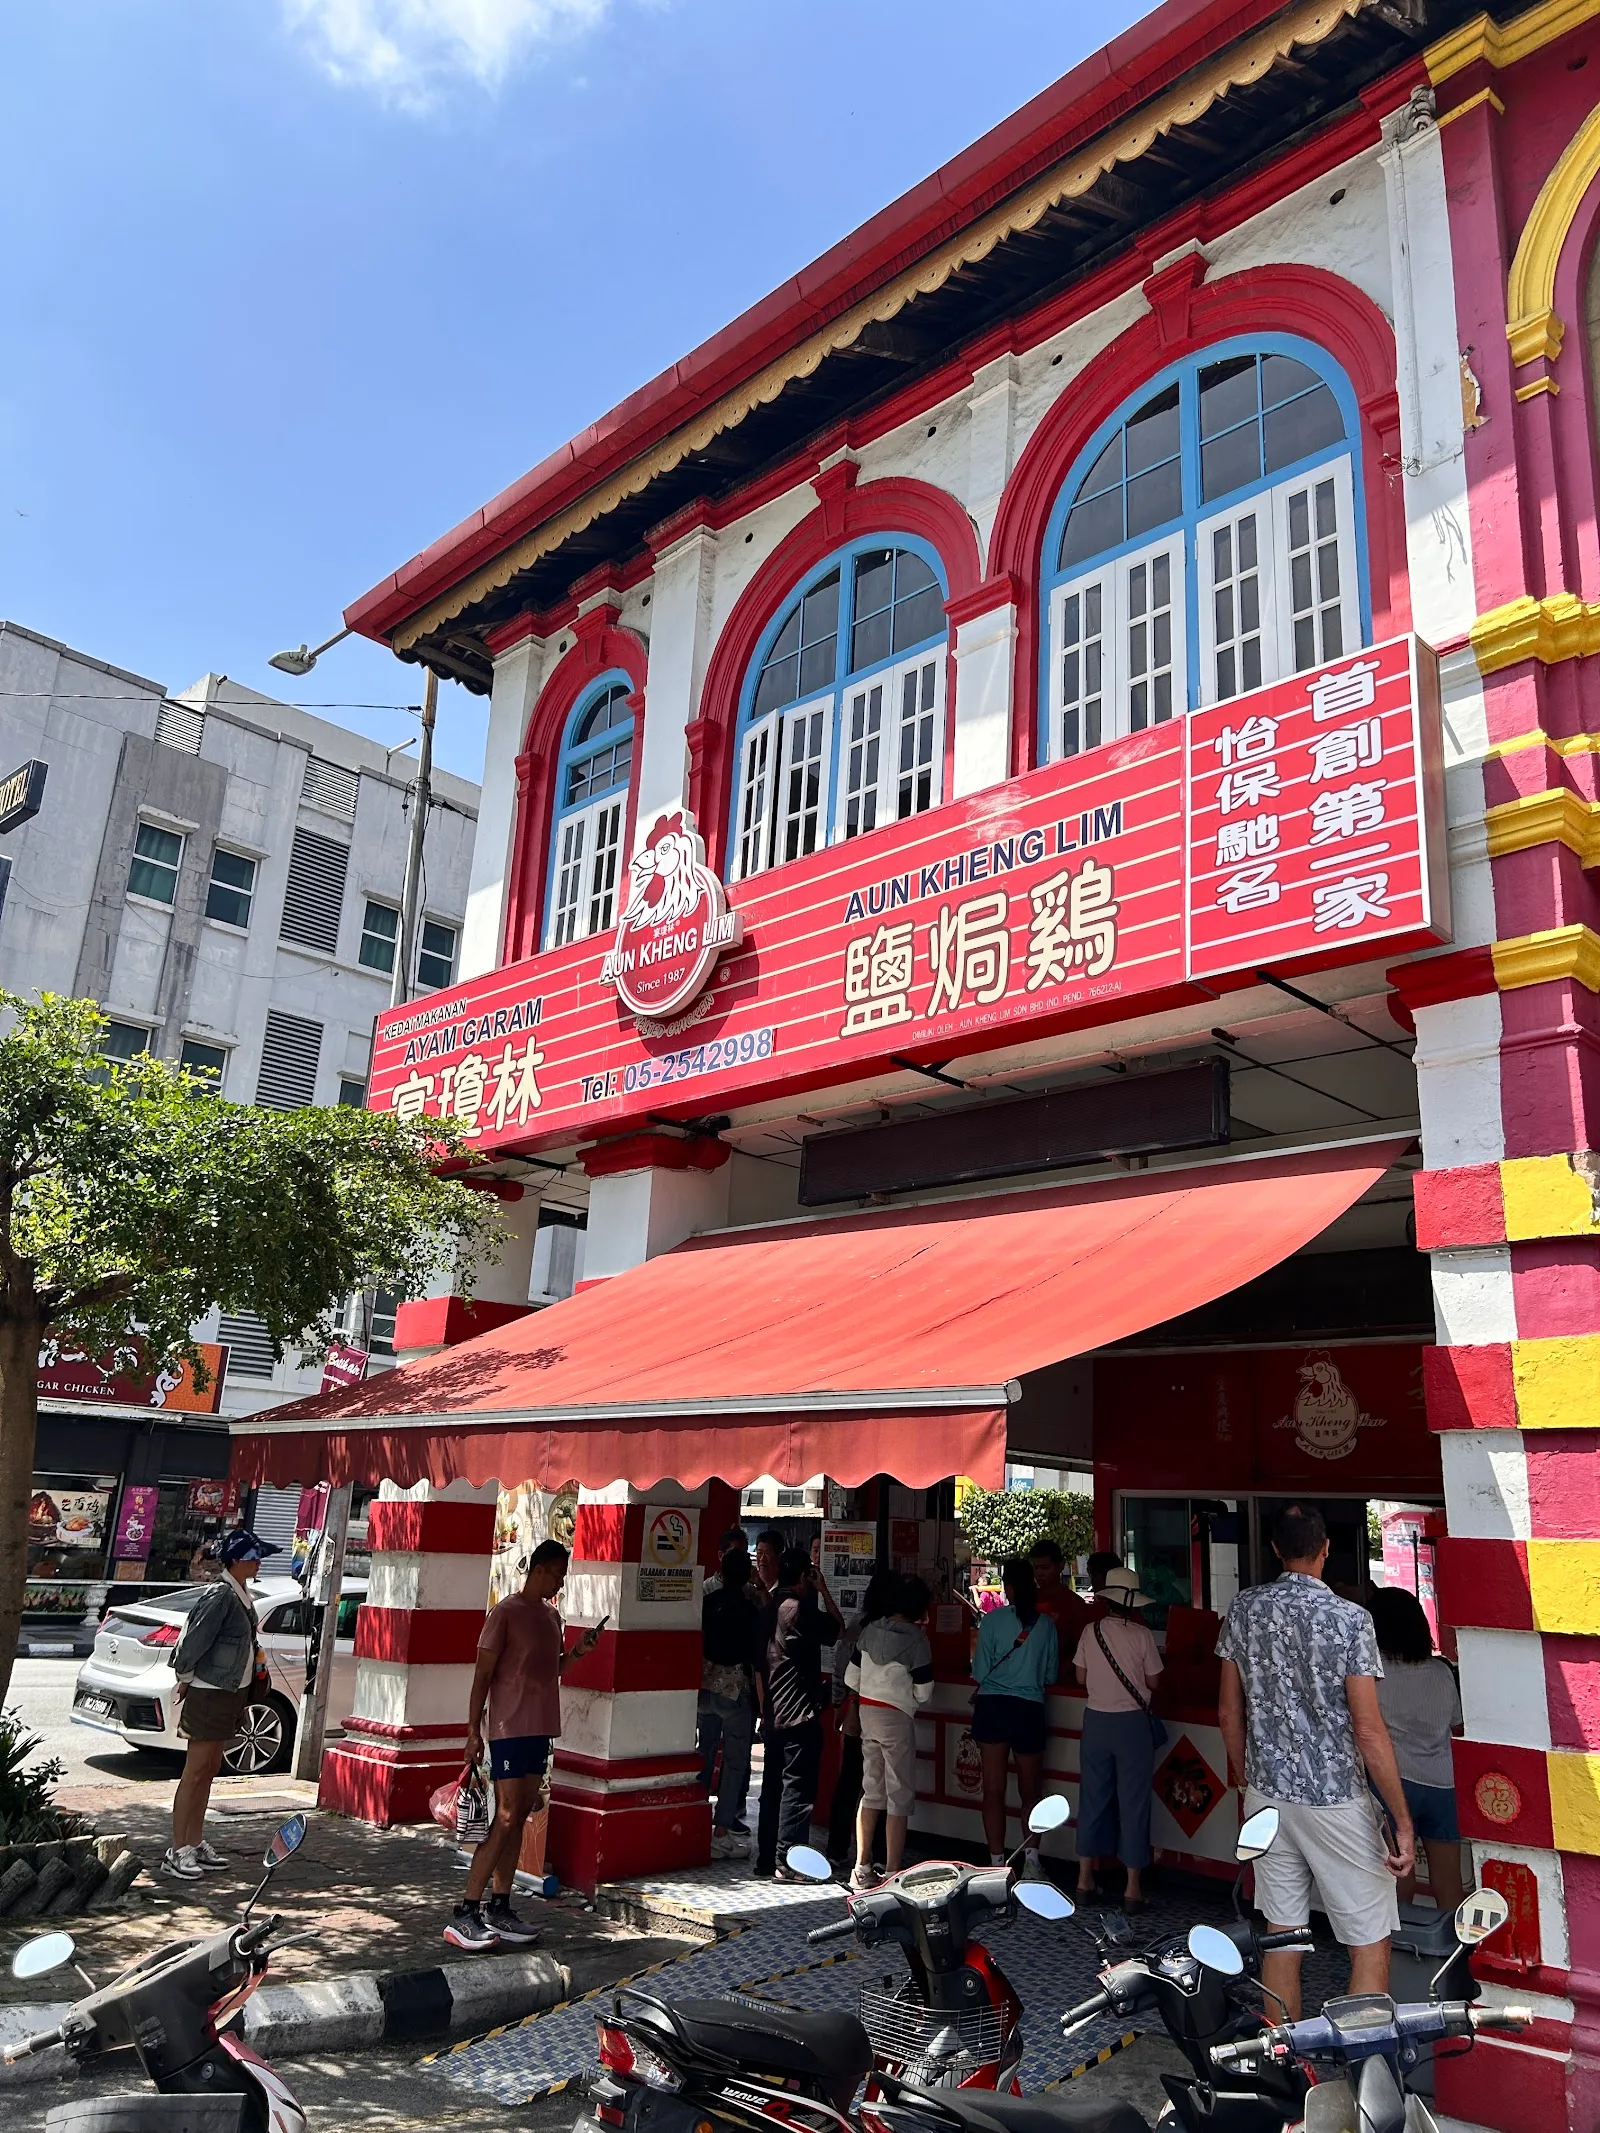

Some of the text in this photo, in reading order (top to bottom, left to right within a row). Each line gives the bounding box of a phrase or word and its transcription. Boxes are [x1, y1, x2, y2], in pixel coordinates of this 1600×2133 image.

[1214, 716, 1281, 913] 怡保馳名
[1306, 660, 1391, 932] 首創第一家
[844, 801, 1123, 923] AUN KHENG LIM
[601, 914, 734, 981] AUN KHENG LIM
[636, 967, 685, 994] Since 1987
[383, 1000, 467, 1040] KEDAI MAKANAN
[403, 997, 543, 1066] AYAM GARAM
[937, 1024, 953, 1036] OLEH
[959, 1018, 973, 1030] AUN
[975, 1013, 997, 1026] KHENG
[1000, 1010, 1011, 1020] LIM
[1013, 1005, 1028, 1017] SDN
[1030, 1001, 1044, 1013] BHD
[581, 1028, 772, 1103] Tel: 05-2542998
[63, 1383, 116, 1396] CHICKEN
[1305, 1415, 1352, 1432] Kheng
[667, 1568, 694, 1578] MEROKOK
